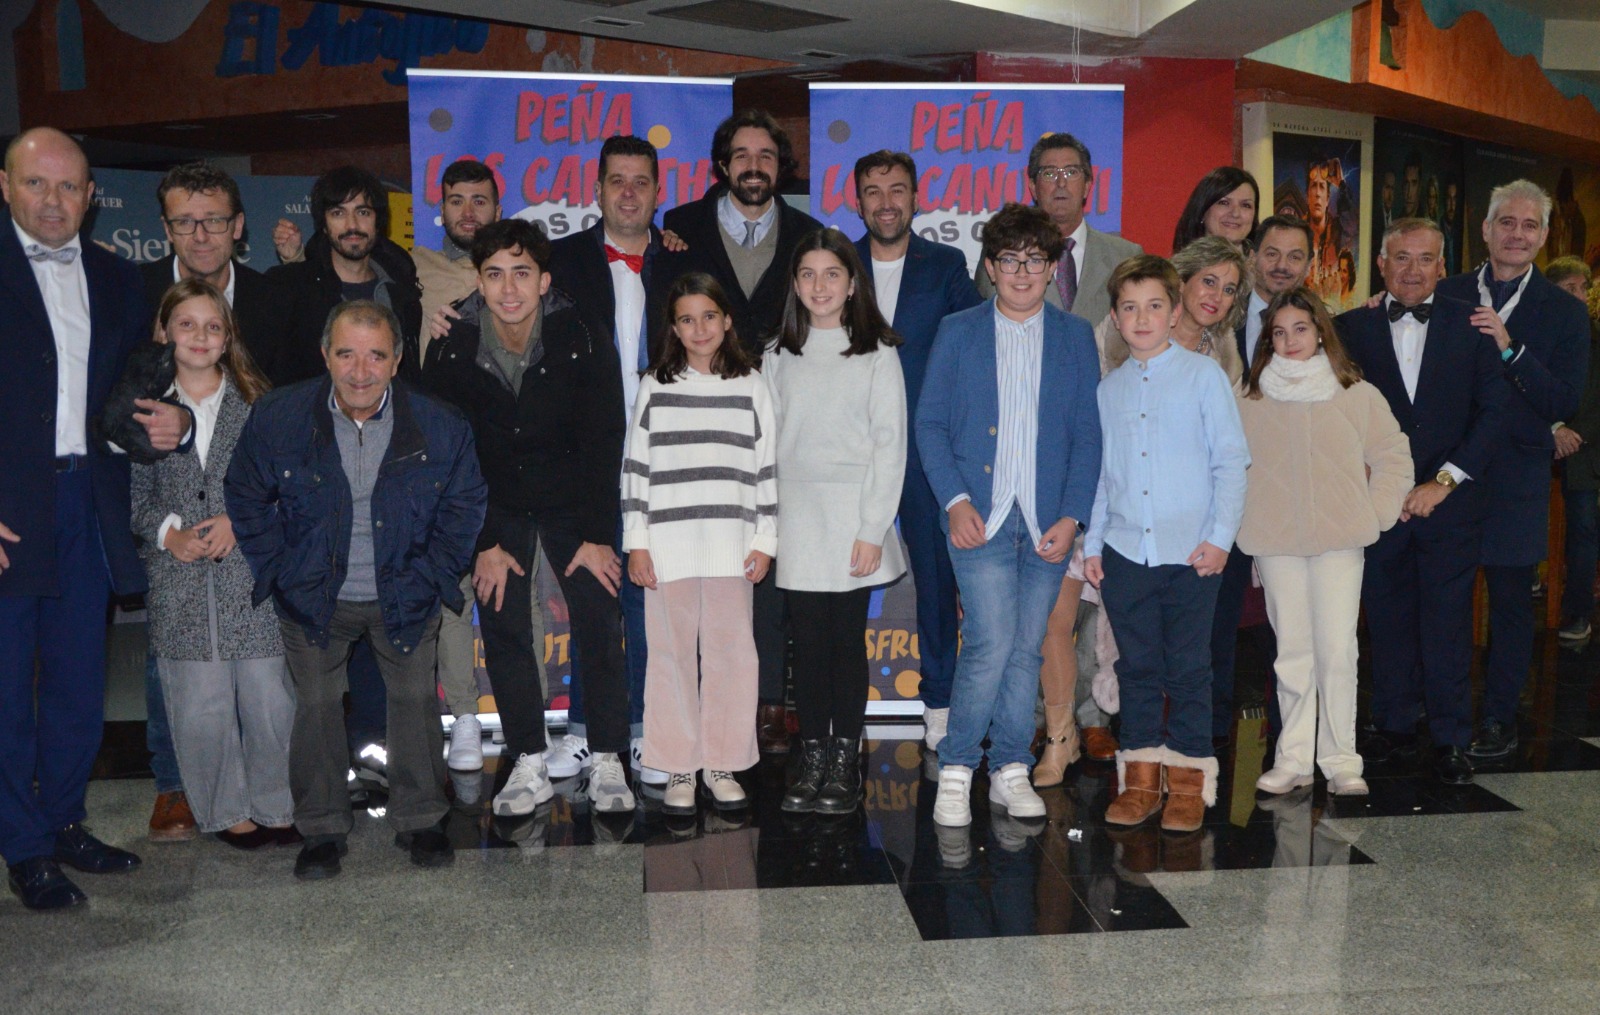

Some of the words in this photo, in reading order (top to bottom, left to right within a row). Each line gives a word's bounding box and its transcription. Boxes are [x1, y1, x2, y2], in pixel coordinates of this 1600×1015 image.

[516, 82, 633, 144] PEÑA
[909, 91, 1024, 154] PEÑA
[285, 203, 311, 214] SALA
